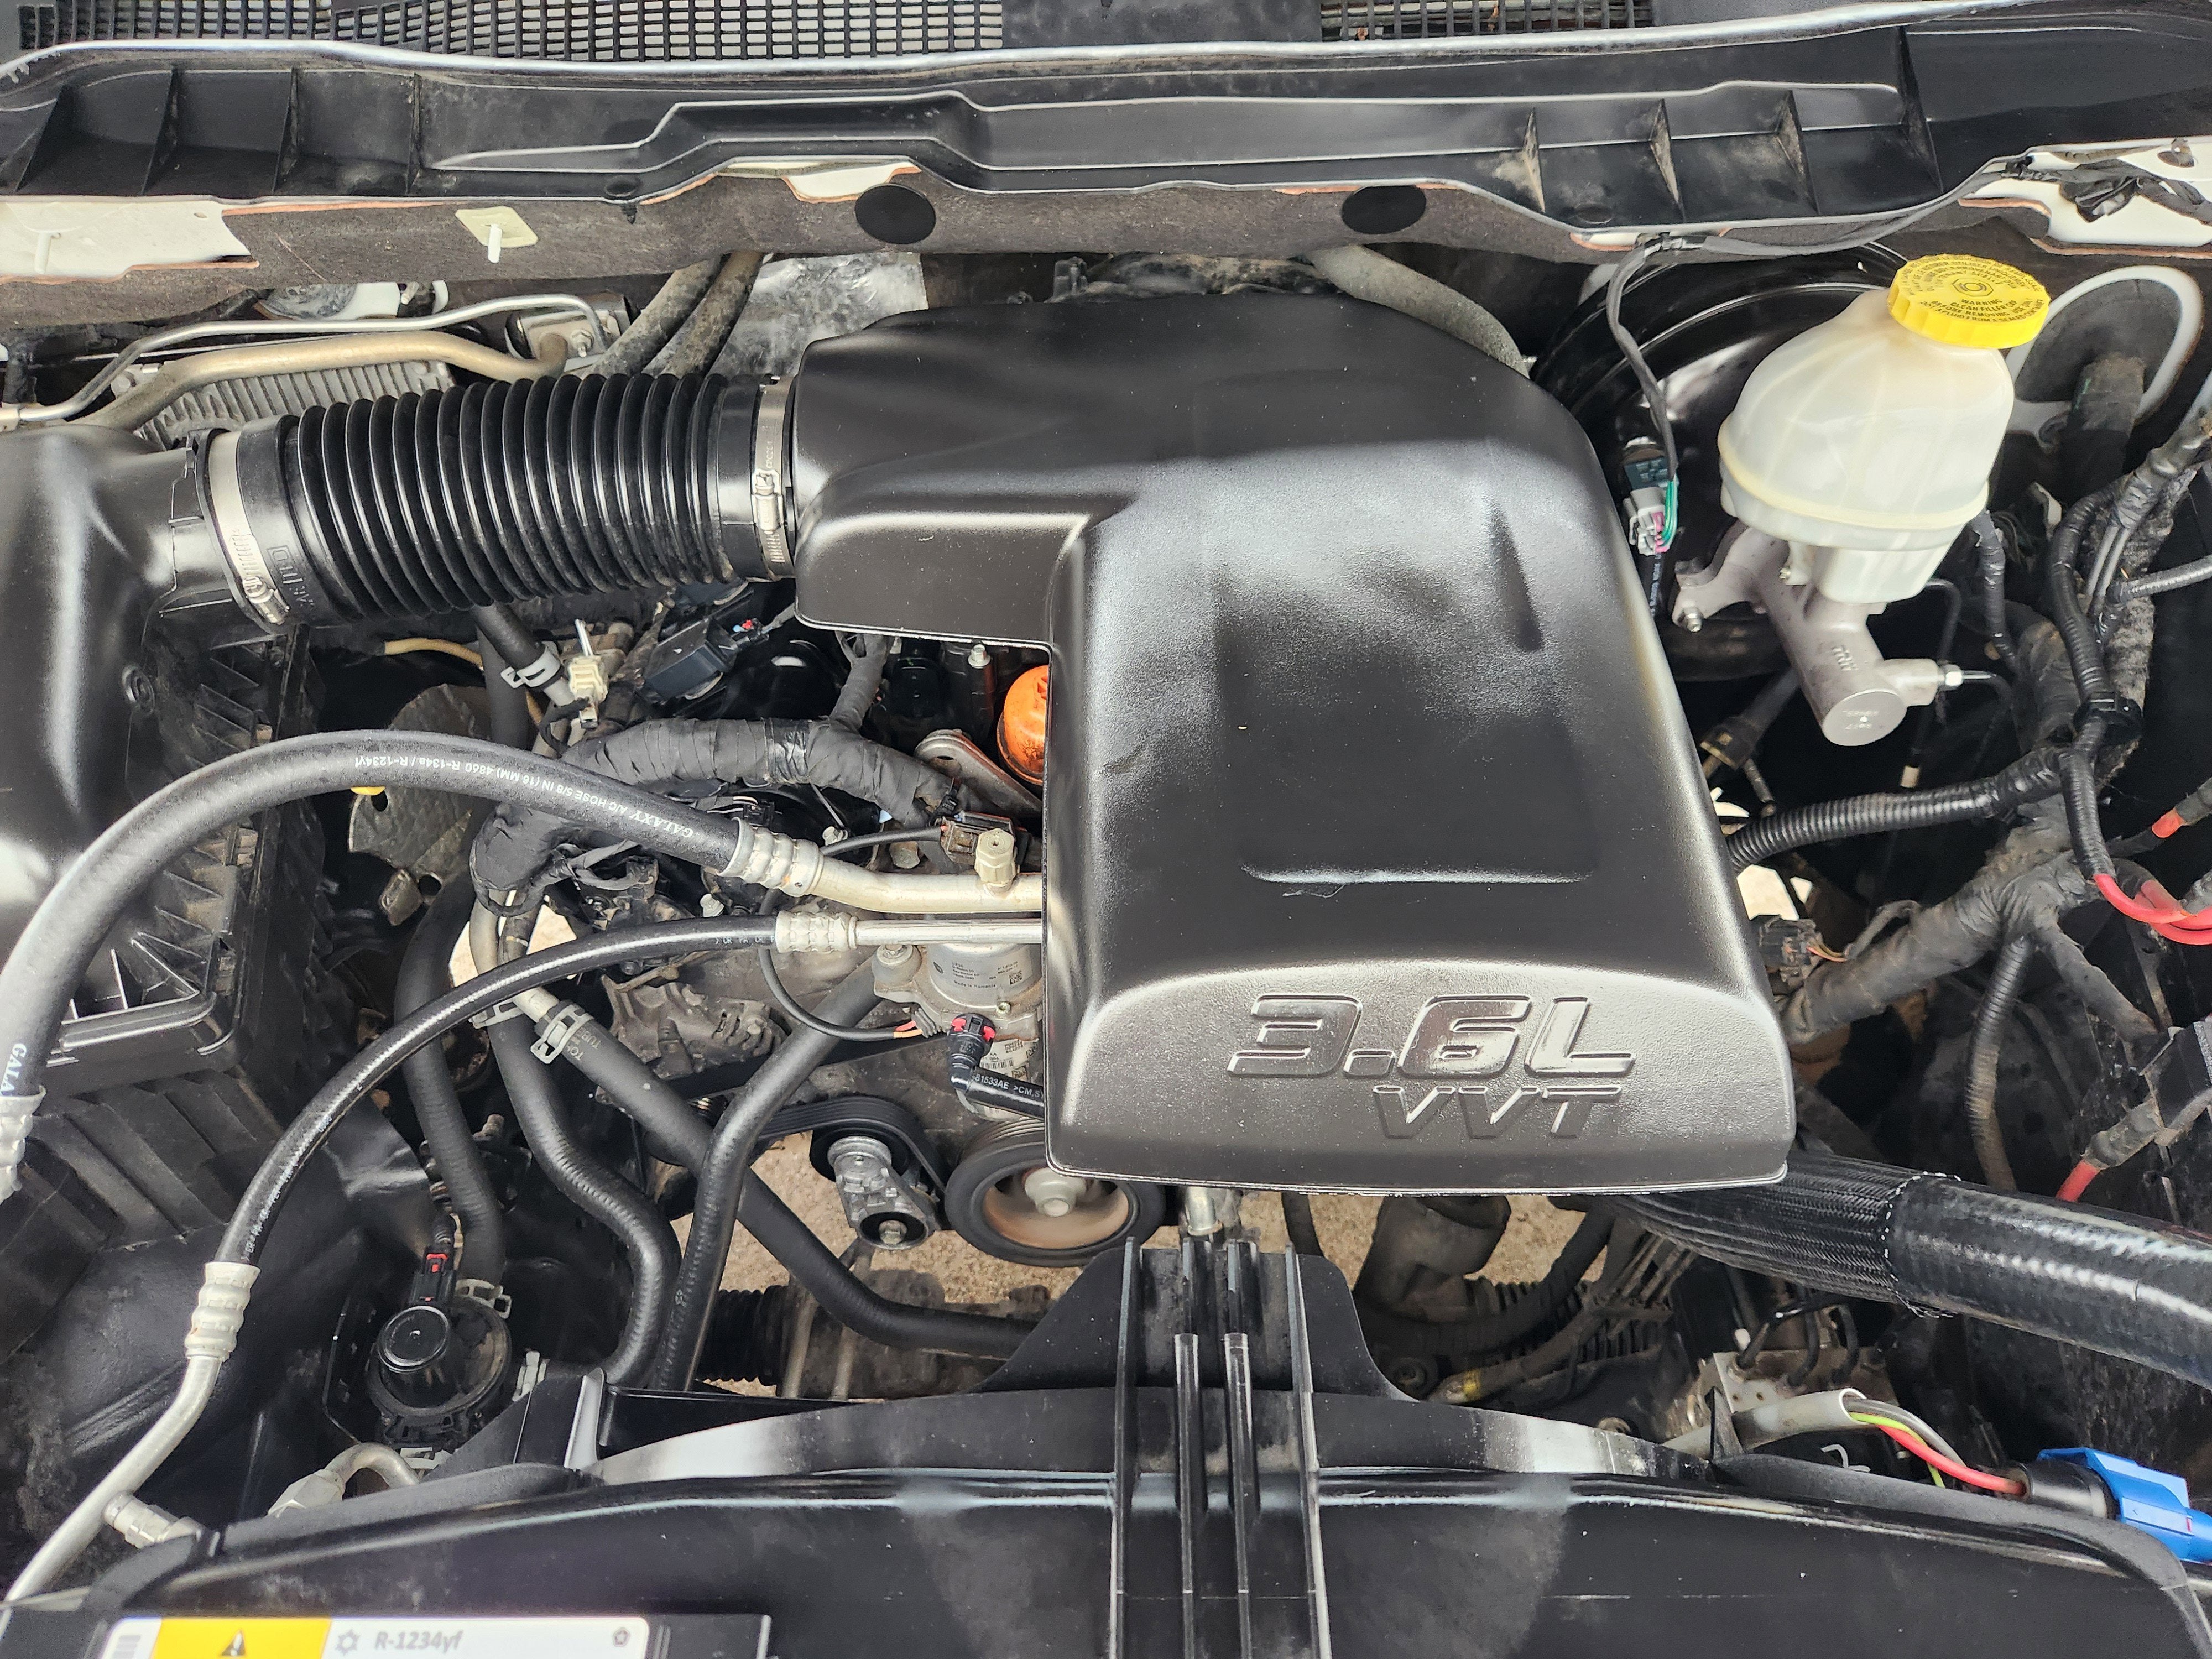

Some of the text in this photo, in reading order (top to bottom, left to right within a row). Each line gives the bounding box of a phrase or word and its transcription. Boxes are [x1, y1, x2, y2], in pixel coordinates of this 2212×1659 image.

[1932, 301, 1962, 313] BEFORE
[1950, 302, 1978, 311] CLEAN
[1942, 310, 1965, 319] FLUID
[354, 756, 408, 768] R-1234yf
[419, 757, 460, 770] R-134a
[465, 763, 494, 775] 4860
[496, 767, 520, 781] MM)
[522, 775, 540, 787] (16
[542, 780, 555, 791] IN
[556, 784, 573, 797] 5/8
[575, 790, 607, 808] HOSE
[608, 801, 628, 814] A/C
[629, 810, 693, 838] GALAXY
[1228, 994, 1635, 1078] 3.6L
[1373, 1086, 1621, 1139] VVT
[374, 1629, 464, 1654] R-1234yf
